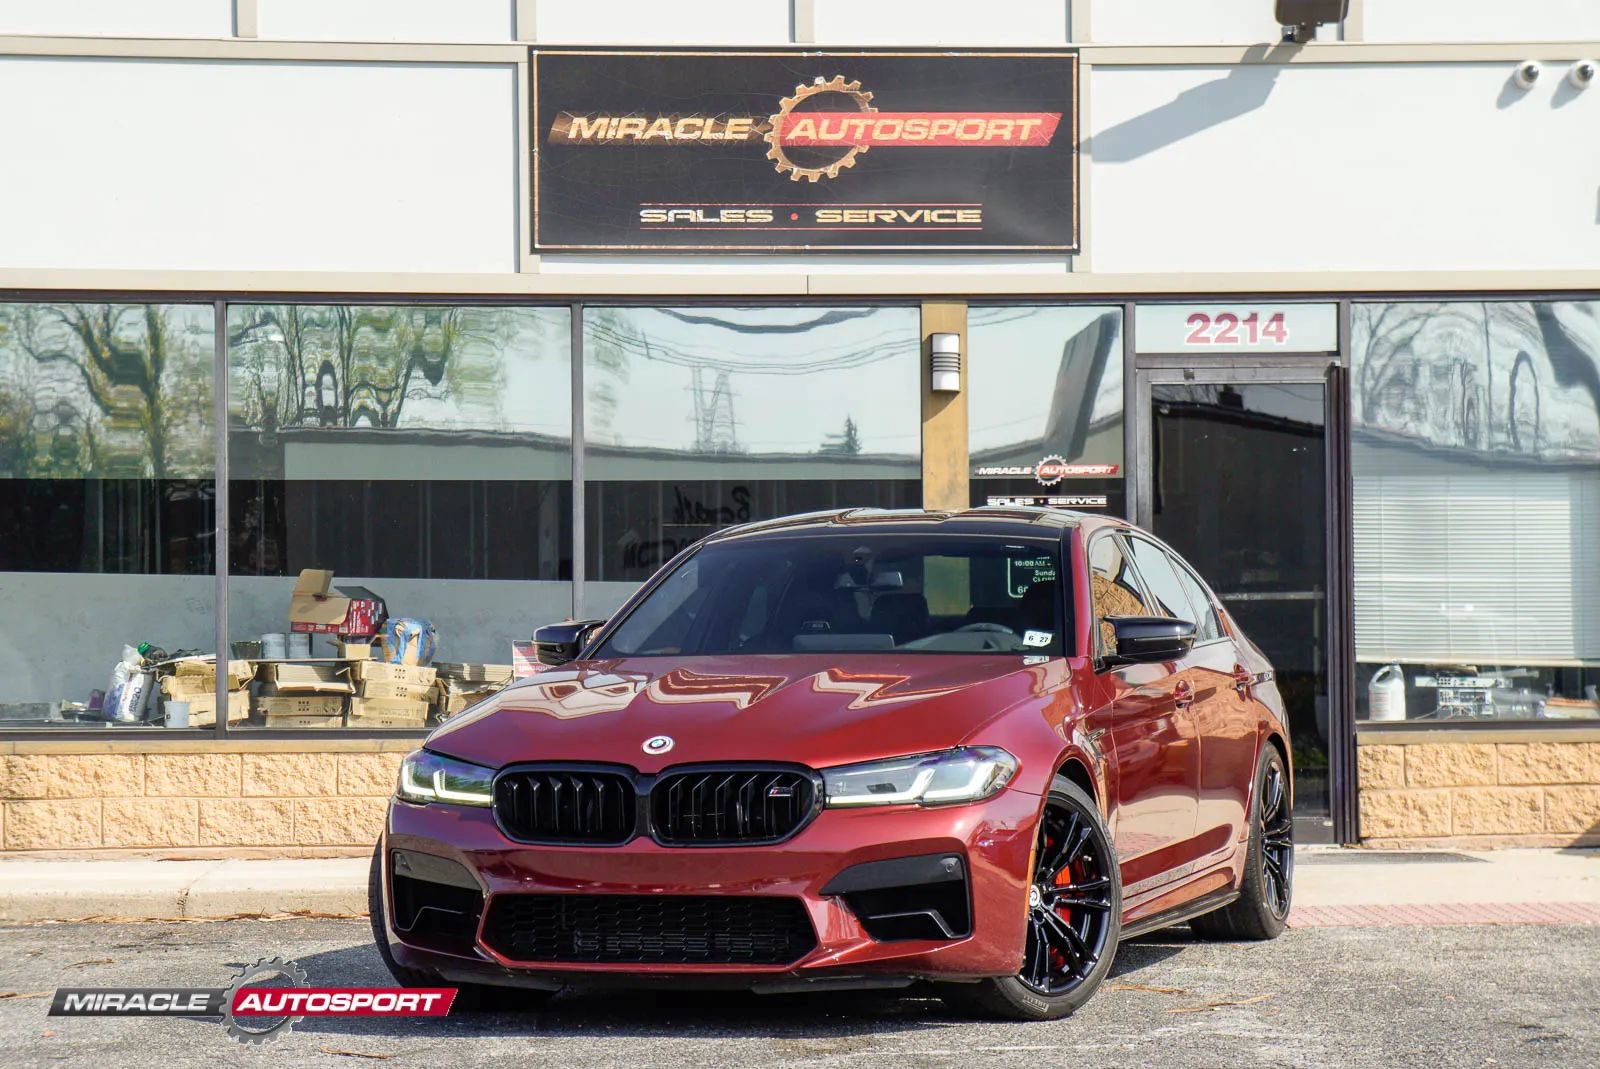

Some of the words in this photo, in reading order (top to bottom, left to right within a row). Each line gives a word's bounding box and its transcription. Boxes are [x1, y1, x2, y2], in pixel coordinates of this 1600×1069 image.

[567, 117, 753, 140] MIRACLE
[785, 118, 1042, 141] AUTOSPORT
[639, 209, 774, 223] SALES
[815, 209, 982, 223] SERVICE
[1185, 311, 1288, 345] 2214
[978, 466, 1032, 475] MIRACLE
[1041, 465, 1114, 475] AUTOSPORT
[987, 497, 1035, 506] SALES
[1047, 497, 1107, 506] SERVICE
